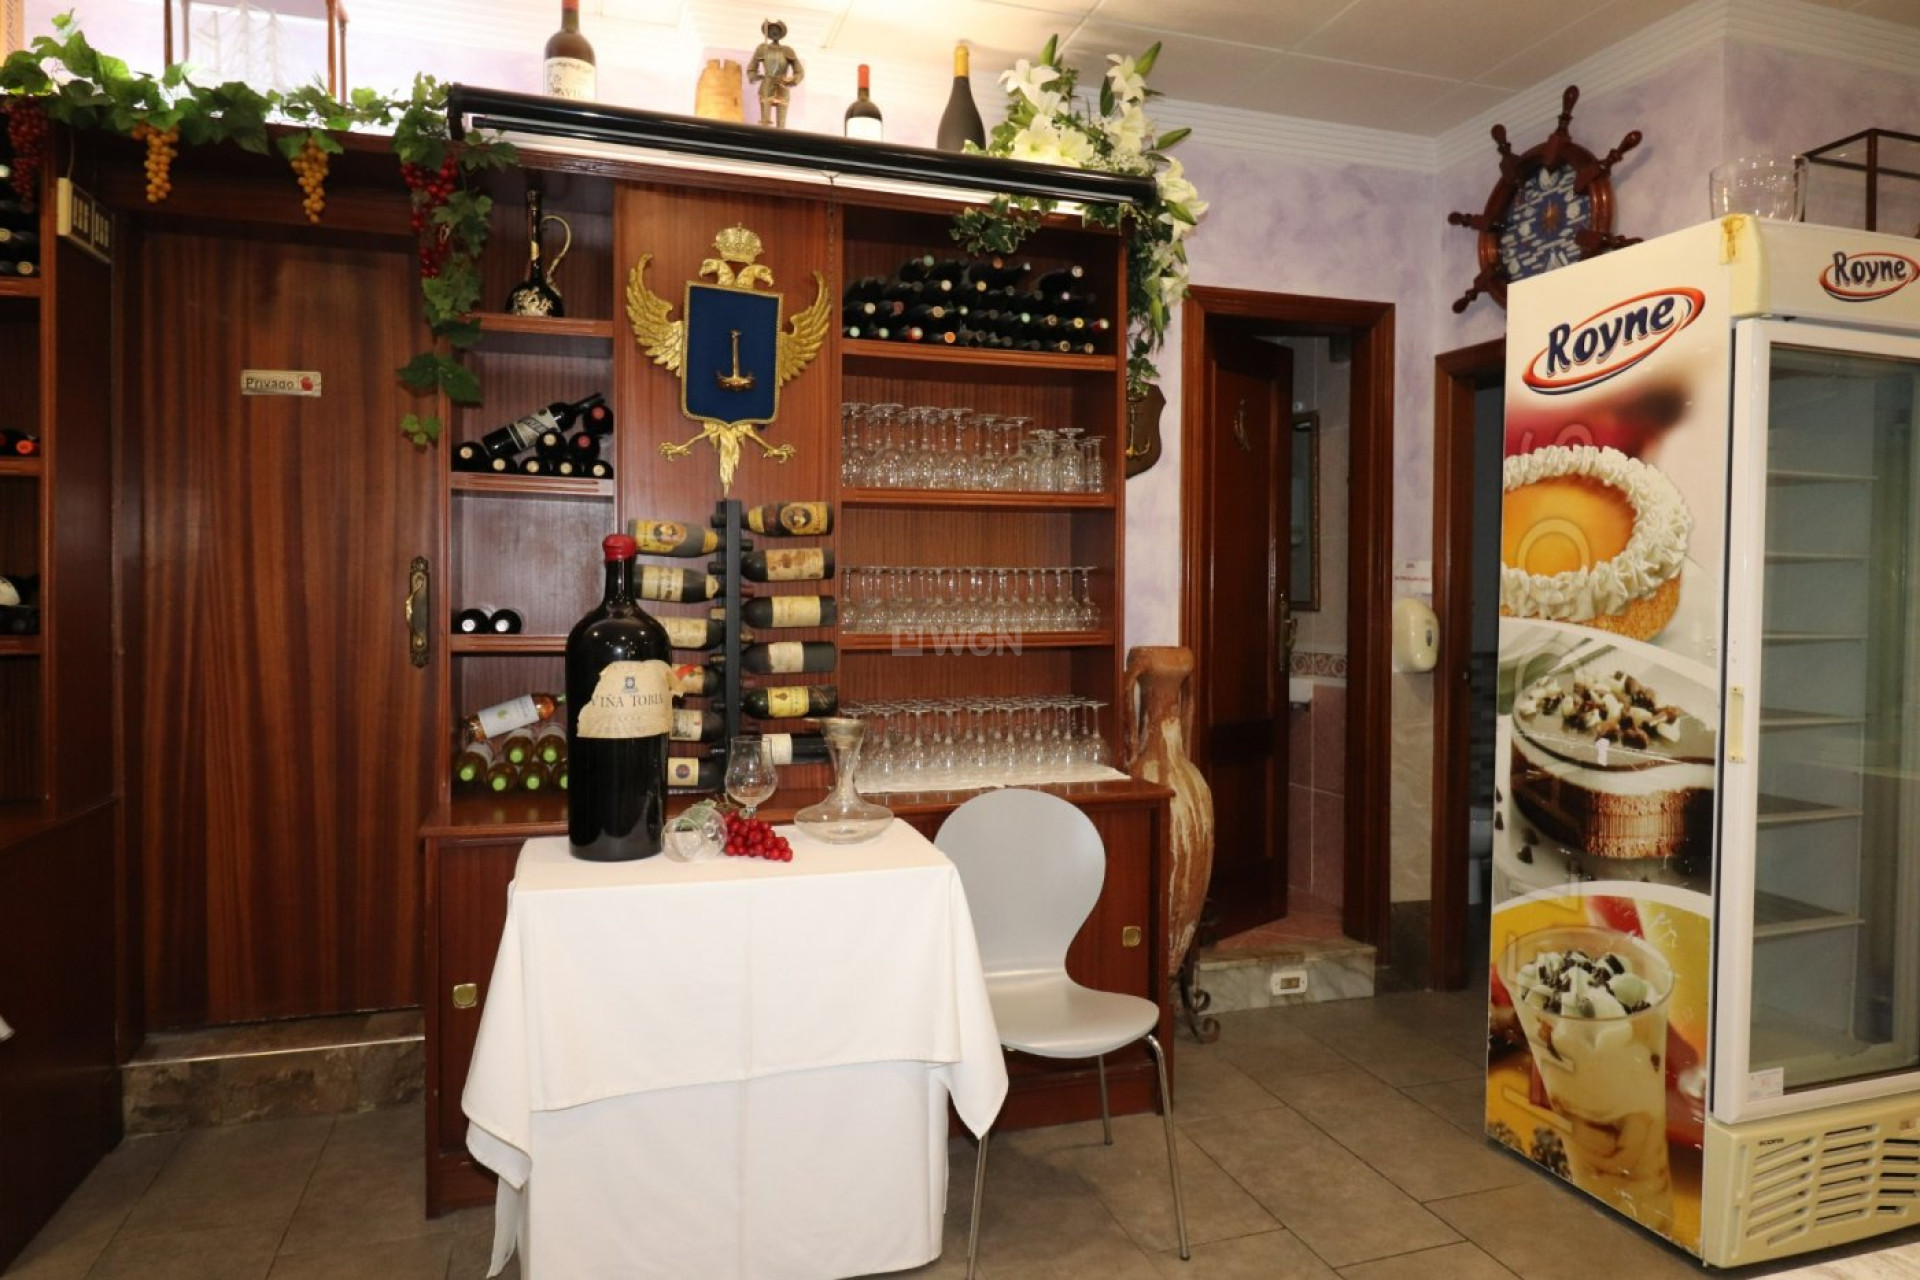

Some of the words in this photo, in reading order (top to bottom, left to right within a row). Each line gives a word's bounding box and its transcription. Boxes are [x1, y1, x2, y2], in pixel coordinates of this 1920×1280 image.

[1832, 251, 1906, 286] Royne
[1546, 297, 1675, 376] Royne
[246, 377, 294, 390] Privado
